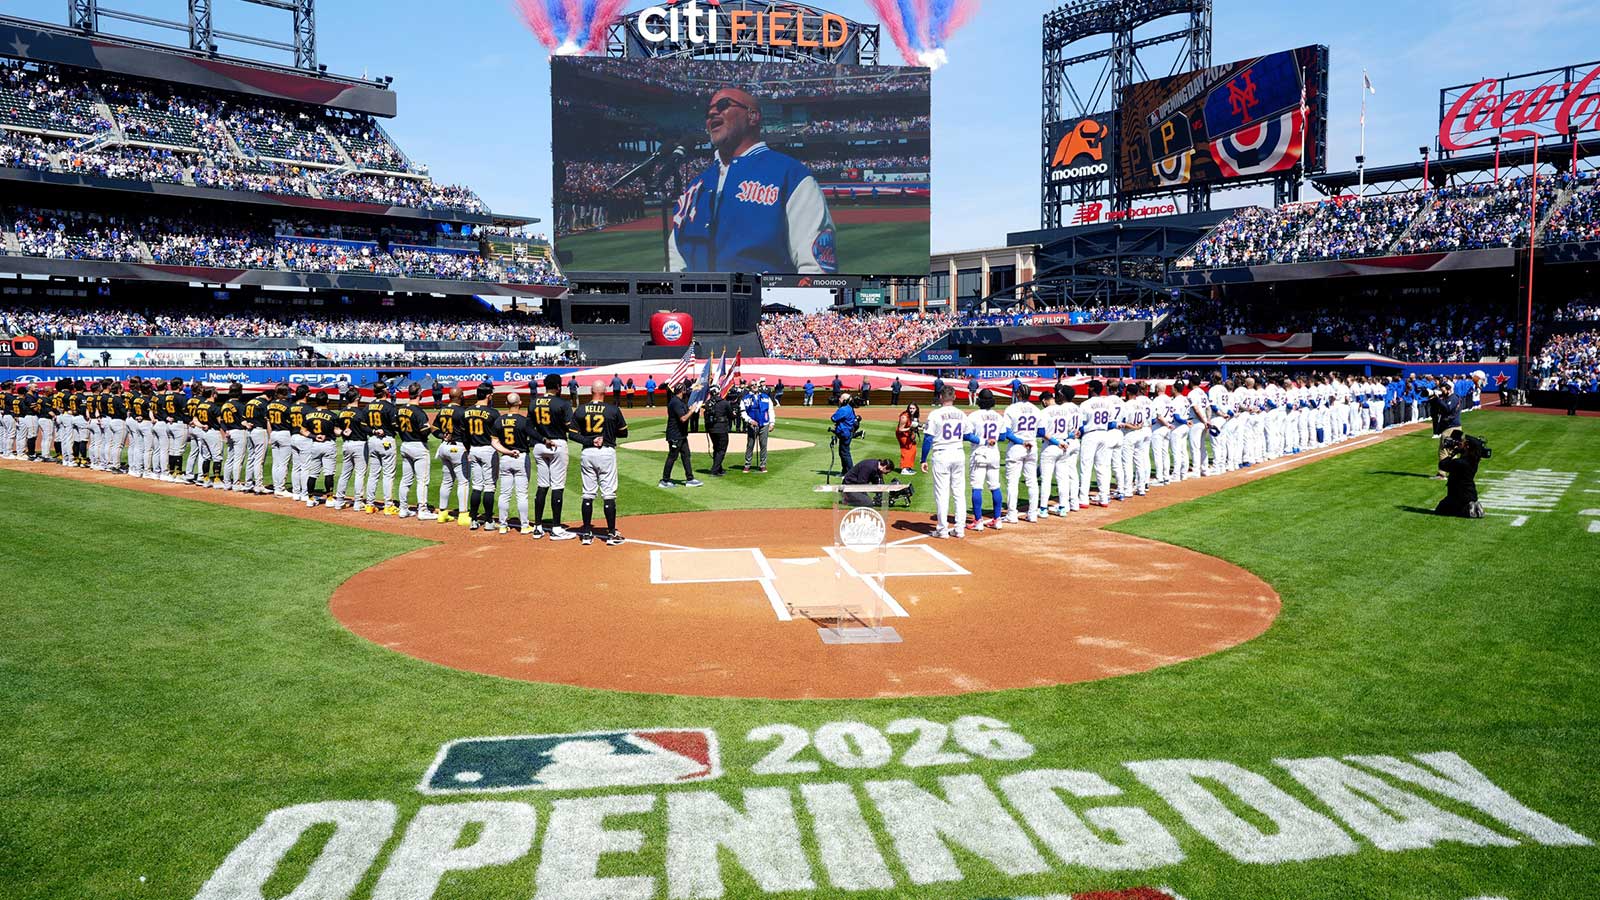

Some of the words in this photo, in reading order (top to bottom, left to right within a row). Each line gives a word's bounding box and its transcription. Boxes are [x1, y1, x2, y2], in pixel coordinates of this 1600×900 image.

[638, 0, 717, 44] citi
[731, 10, 849, 48] FIELD
[1158, 88, 1188, 119] OPENING
[1186, 72, 1205, 99] DAY
[1440, 65, 1600, 150] Coca-Co
[1051, 163, 1108, 181] moomoo
[735, 180, 779, 206] Mets
[1105, 210, 1127, 220] new
[1128, 204, 1175, 218] balance
[22, 342, 35, 350] 00
[535, 398, 552, 406] CRUZ
[585, 405, 606, 413] KELLY
[464, 409, 491, 420] REYNOLDS
[534, 407, 552, 425] 15
[1017, 415, 1037, 431] 22
[1094, 411, 1109, 425] 88
[1133, 412, 1143, 424] 10
[313, 419, 322, 434] 3
[468, 418, 484, 436] 10
[585, 414, 605, 434] 12
[943, 422, 962, 440] 64
[983, 423, 998, 439] 12
[1054, 418, 1066, 434] 19
[504, 427, 516, 446] 5
[746, 715, 1035, 775] 2026
[194, 768, 1187, 900] OPENING
[1121, 751, 1595, 866] DAY
